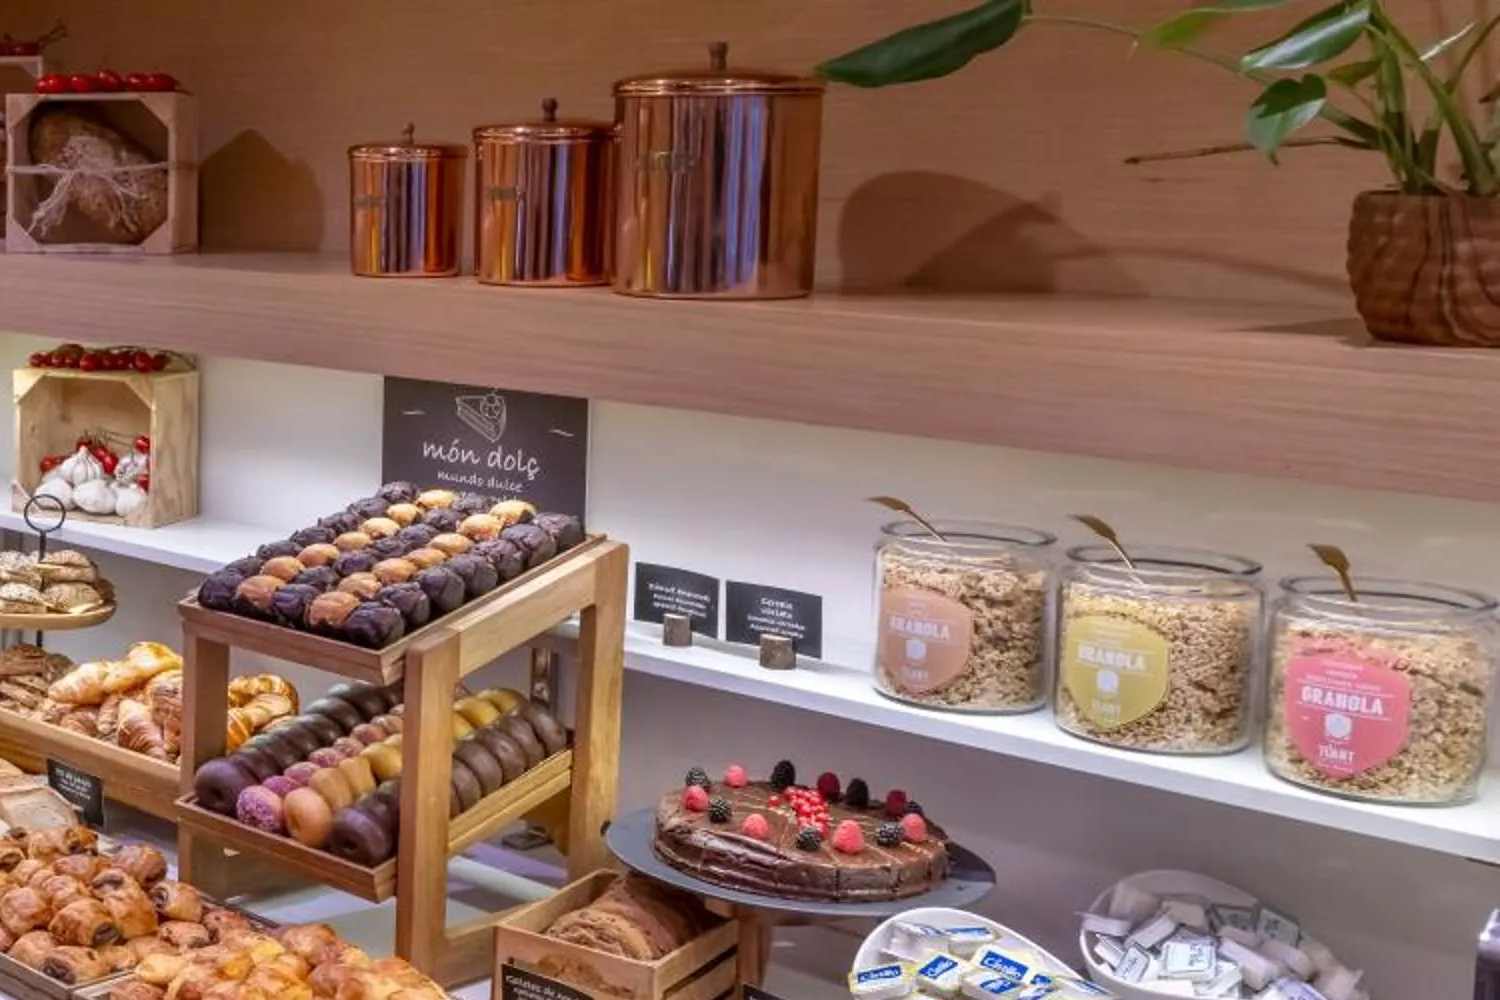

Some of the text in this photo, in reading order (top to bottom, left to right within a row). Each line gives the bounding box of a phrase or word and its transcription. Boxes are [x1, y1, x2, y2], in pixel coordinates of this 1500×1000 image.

[423, 439, 541, 480] món dolç
[487, 475, 524, 493] dulce
[1302, 685, 1383, 715] GRANOLA
